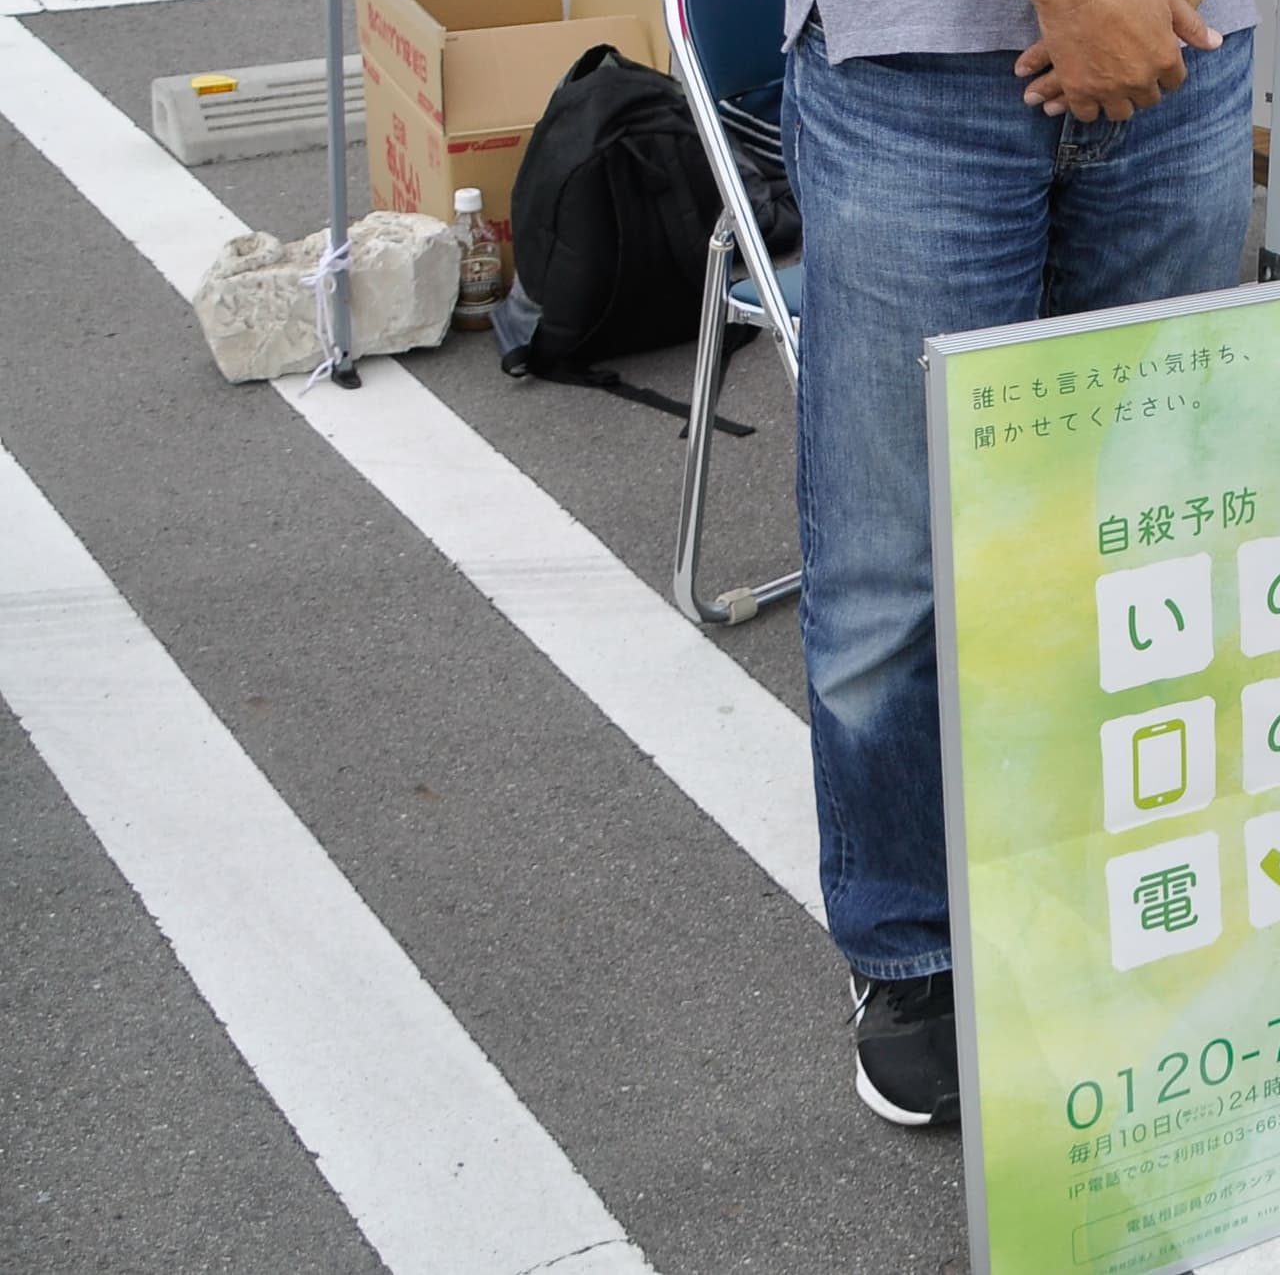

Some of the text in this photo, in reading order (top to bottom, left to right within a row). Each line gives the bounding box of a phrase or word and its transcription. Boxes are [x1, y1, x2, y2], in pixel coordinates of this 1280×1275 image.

[972, 344, 1252, 410] 誰にも言えない気持ち、
[974, 395, 1202, 450] 聞かせてください。
[1099, 487, 1257, 555] 自殺予防
